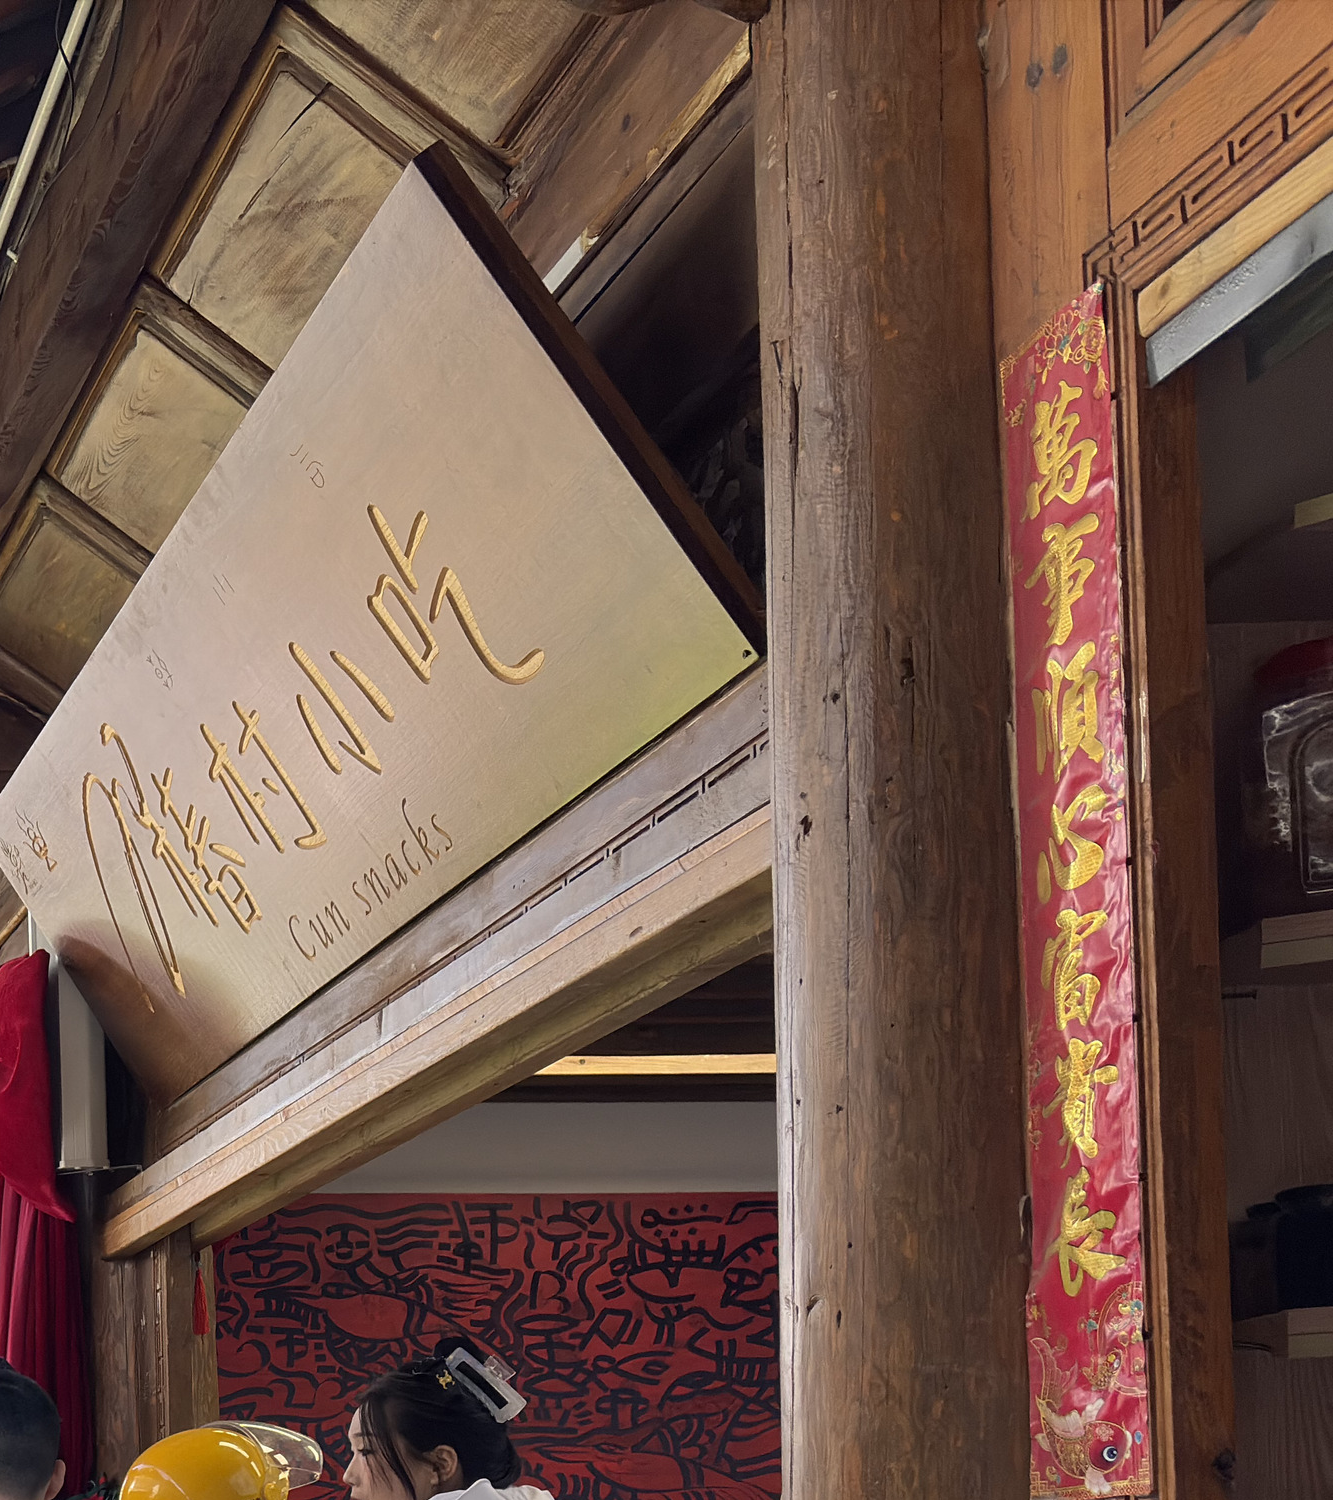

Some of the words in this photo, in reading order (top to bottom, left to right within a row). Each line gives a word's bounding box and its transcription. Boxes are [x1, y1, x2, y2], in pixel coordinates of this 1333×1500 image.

[289, 900, 350, 961] Cun
[352, 797, 453, 916] snacks
[1021, 380, 1126, 1297] 萬事順心富貴長
